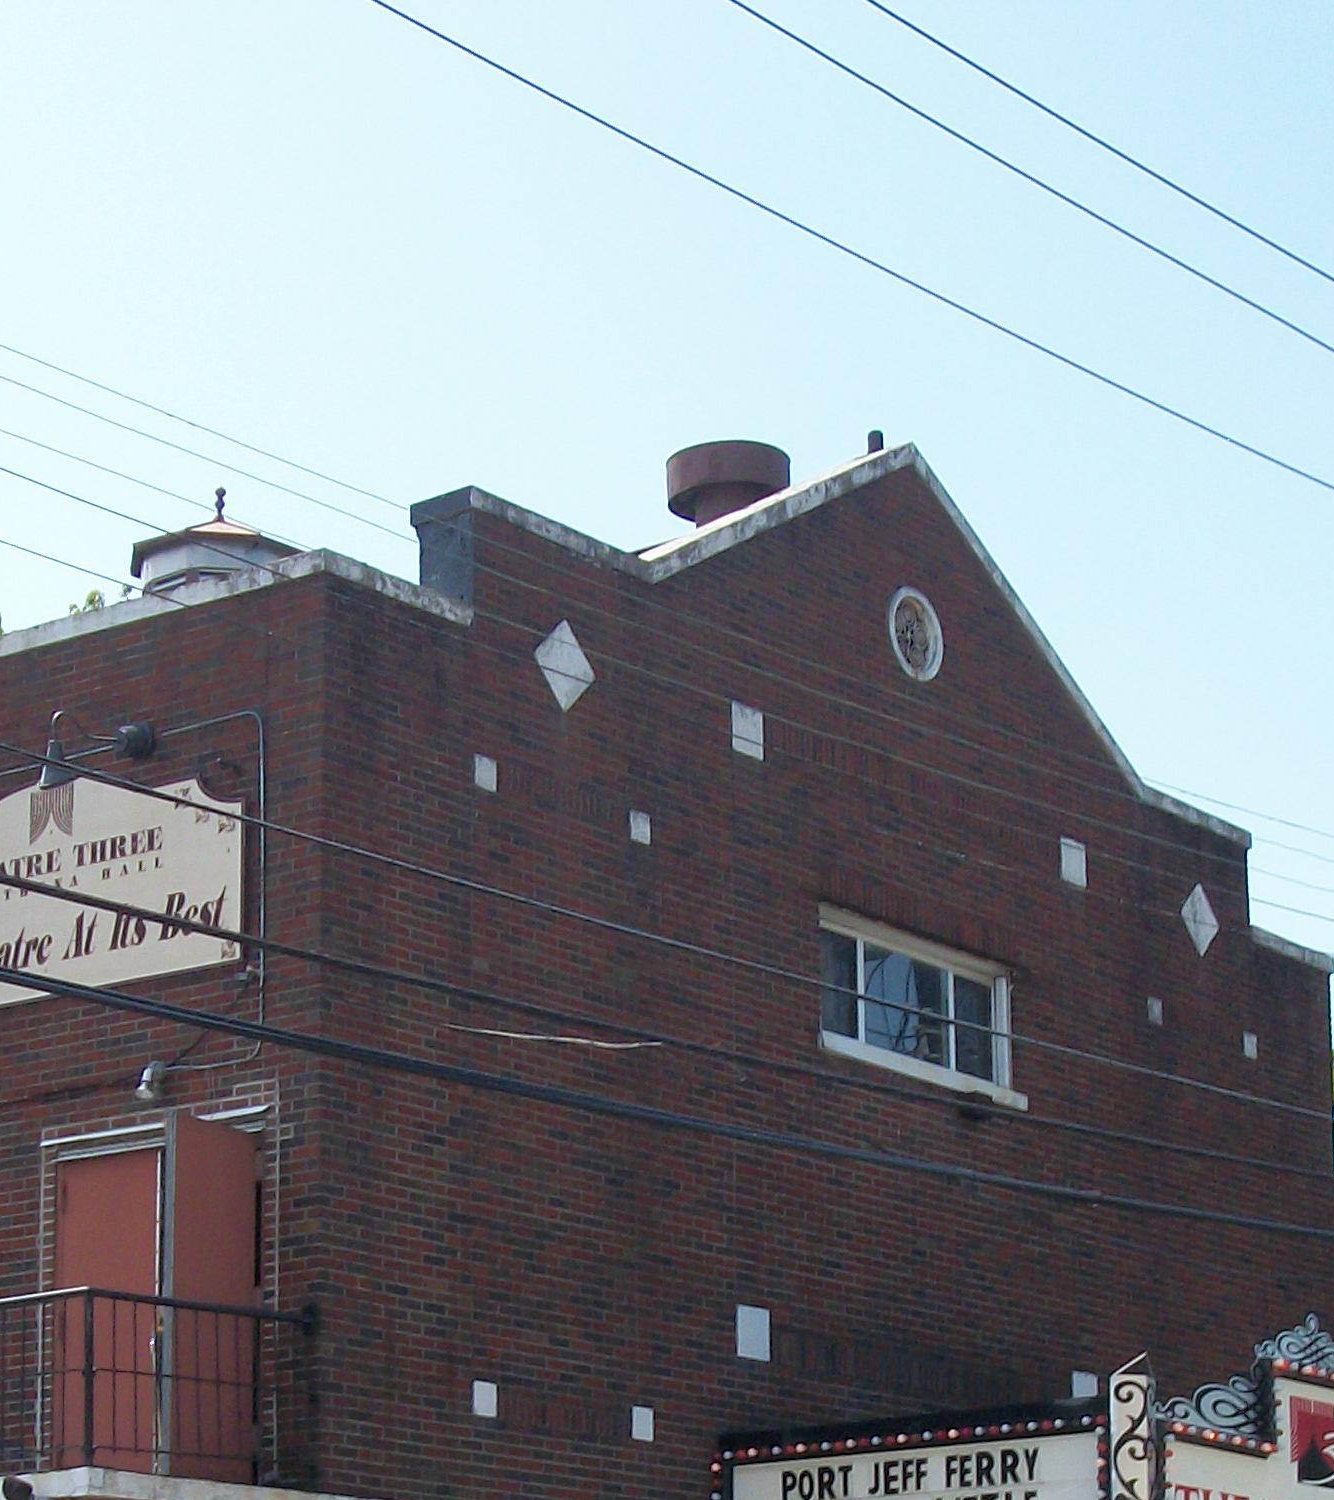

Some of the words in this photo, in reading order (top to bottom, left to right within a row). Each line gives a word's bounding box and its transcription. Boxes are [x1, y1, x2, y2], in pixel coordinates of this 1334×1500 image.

[73, 827, 164, 867] THREE
[101, 856, 163, 880] HALL
[62, 910, 98, 961] At
[108, 904, 147, 950] Its
[158, 885, 226, 941] Best
[868, 1458, 929, 1495] JEFF
[945, 1447, 1040, 1488] FERRY
